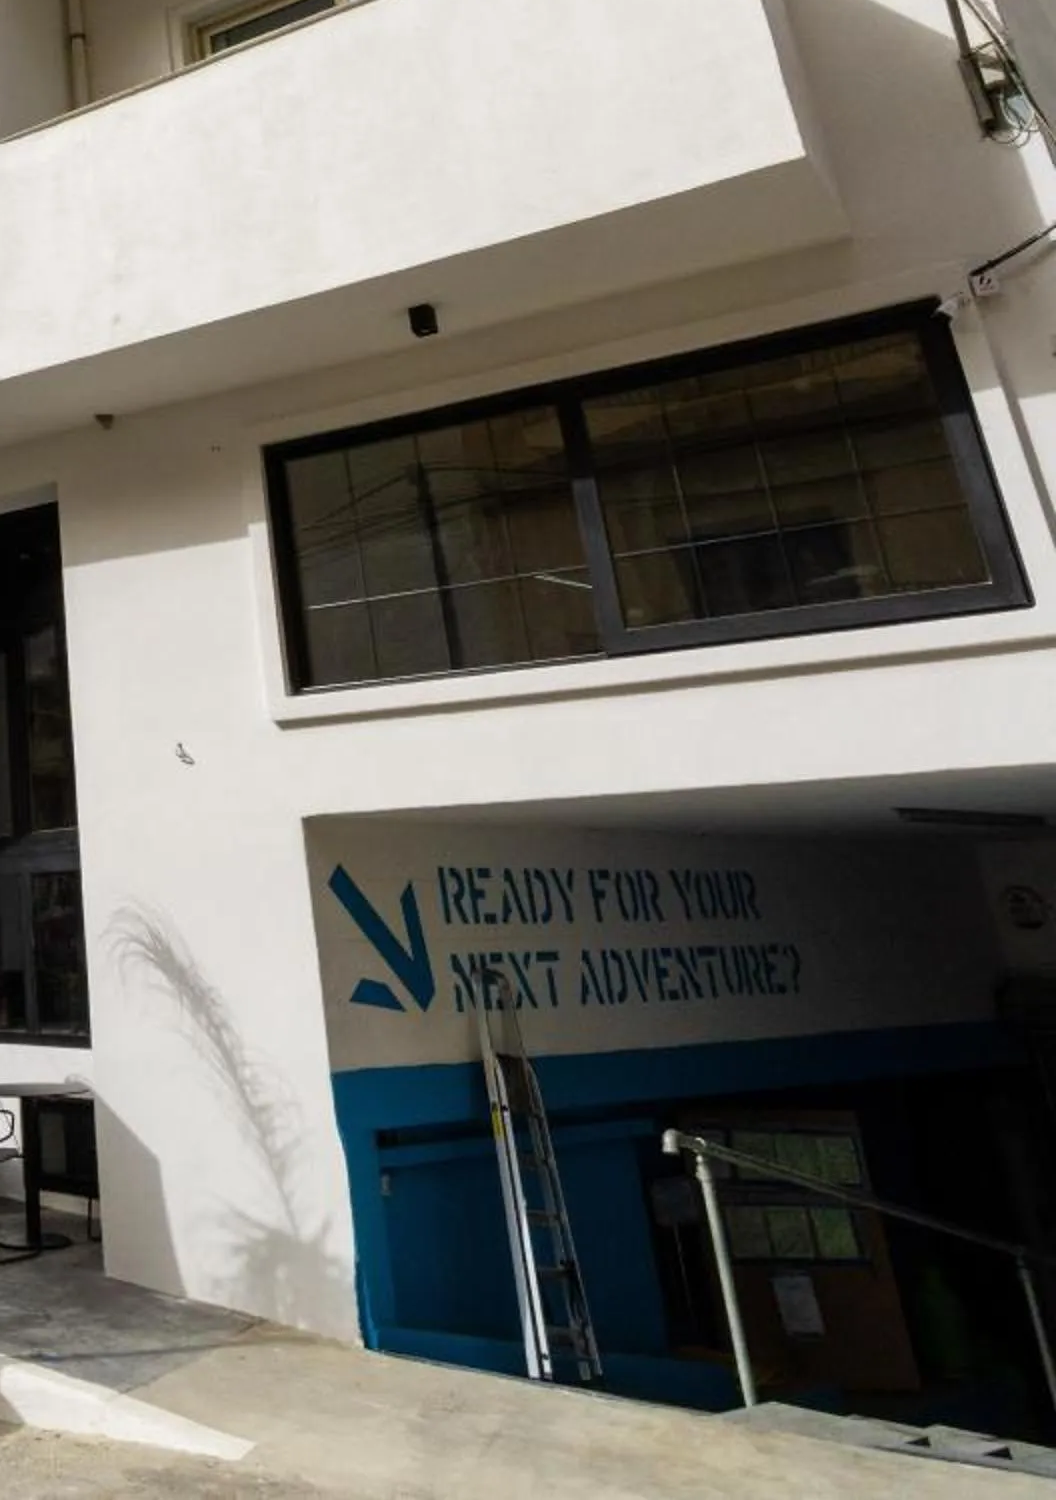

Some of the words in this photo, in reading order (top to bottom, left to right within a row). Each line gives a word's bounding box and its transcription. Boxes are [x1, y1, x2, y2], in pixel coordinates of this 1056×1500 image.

[437, 867, 575, 924] READY
[587, 868, 664, 923] FOR
[671, 868, 763, 921] YOUR
[450, 950, 561, 1012] NEXT
[579, 943, 804, 1006] ADVENTURE?
